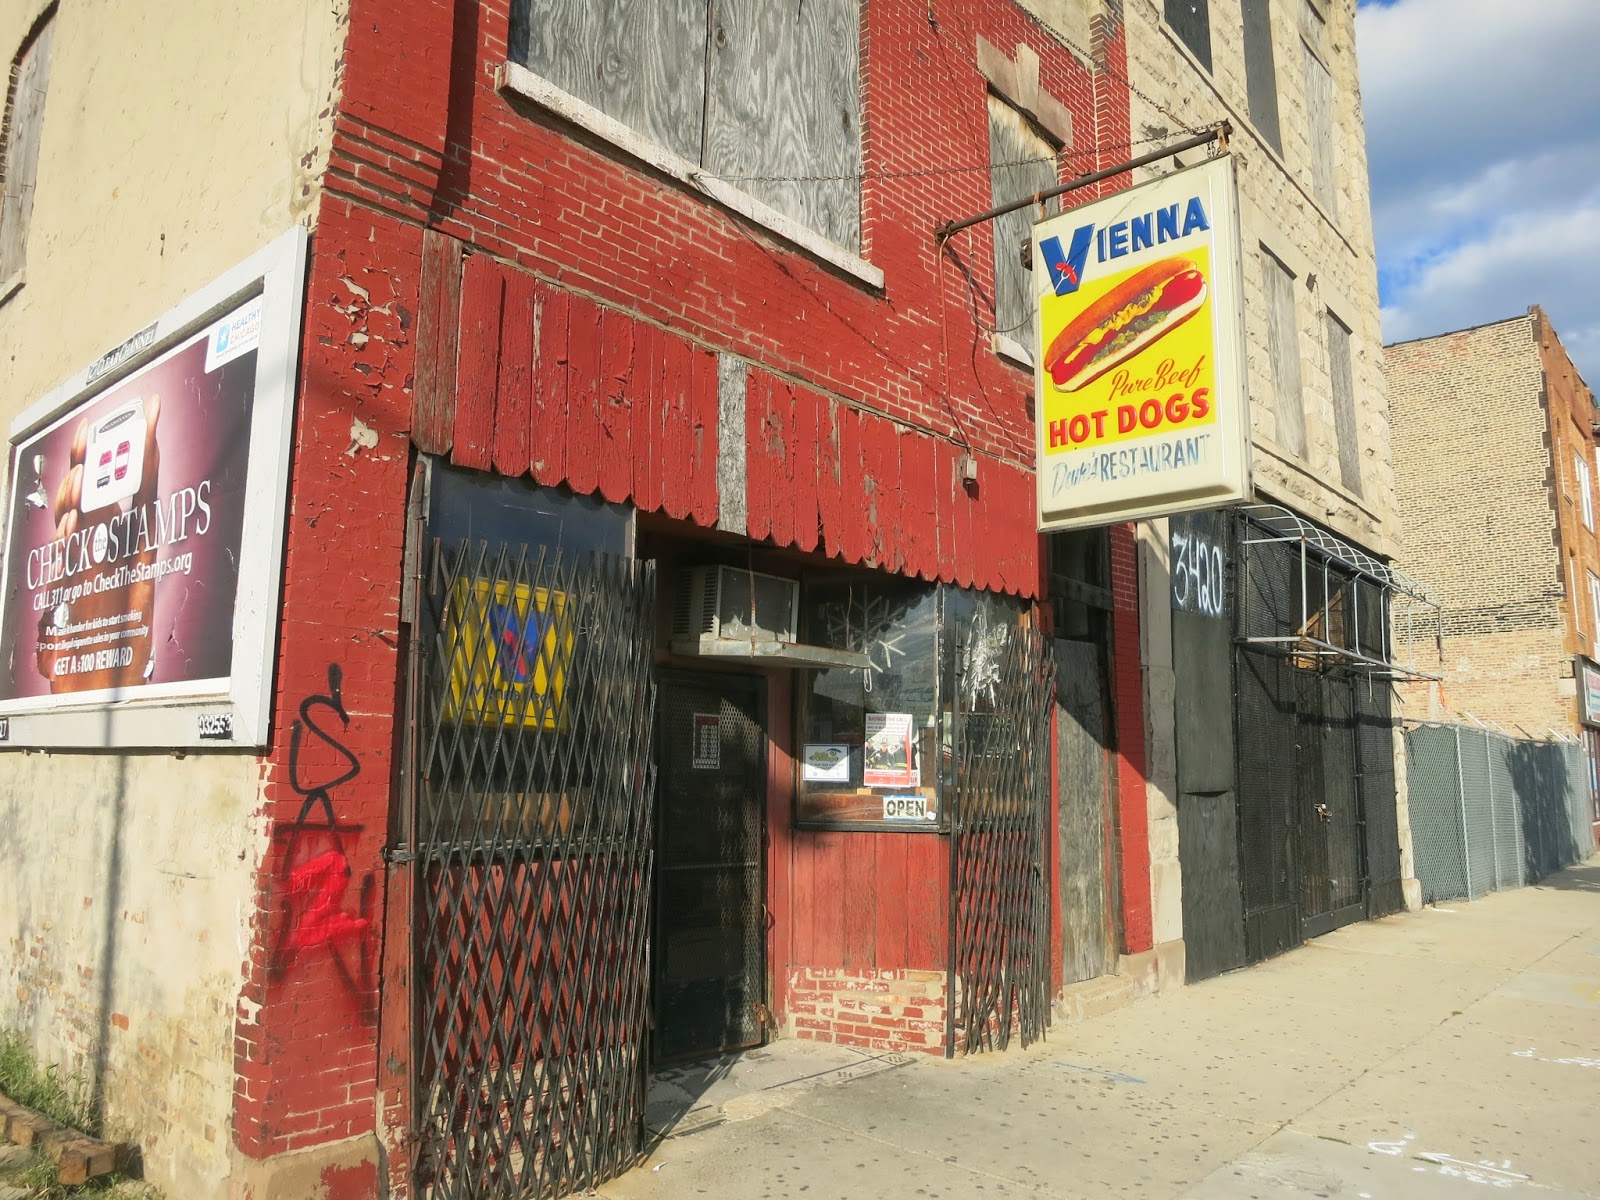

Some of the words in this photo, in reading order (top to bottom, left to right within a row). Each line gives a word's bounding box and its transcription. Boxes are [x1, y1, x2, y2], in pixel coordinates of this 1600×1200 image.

[1039, 196, 1211, 298] VIENNA
[230, 322, 259, 344] CHICAGO
[232, 307, 261, 332] HEALTHY
[1109, 369, 1152, 401] Pure
[1154, 355, 1205, 392] Beef
[1049, 409, 1109, 448] HOT
[1118, 387, 1211, 434] DOGS
[1100, 433, 1211, 482] RESTAURANT
[27, 525, 95, 590] CHECK
[94, 535, 107, 552] the
[107, 480, 212, 563] STAMPS
[33, 590, 50, 611] CALL
[50, 586, 63, 607] 311
[71, 585, 82, 605] go
[83, 582, 92, 596] to
[93, 552, 193, 593] CheckTheStamps.org
[1172, 532, 1222, 615] 3420
[55, 657, 70, 676] GET
[70, 655, 77, 674] A
[77, 652, 94, 673] $100
[95, 646, 133, 670] REWARD
[886, 799, 925, 817] OPEN
